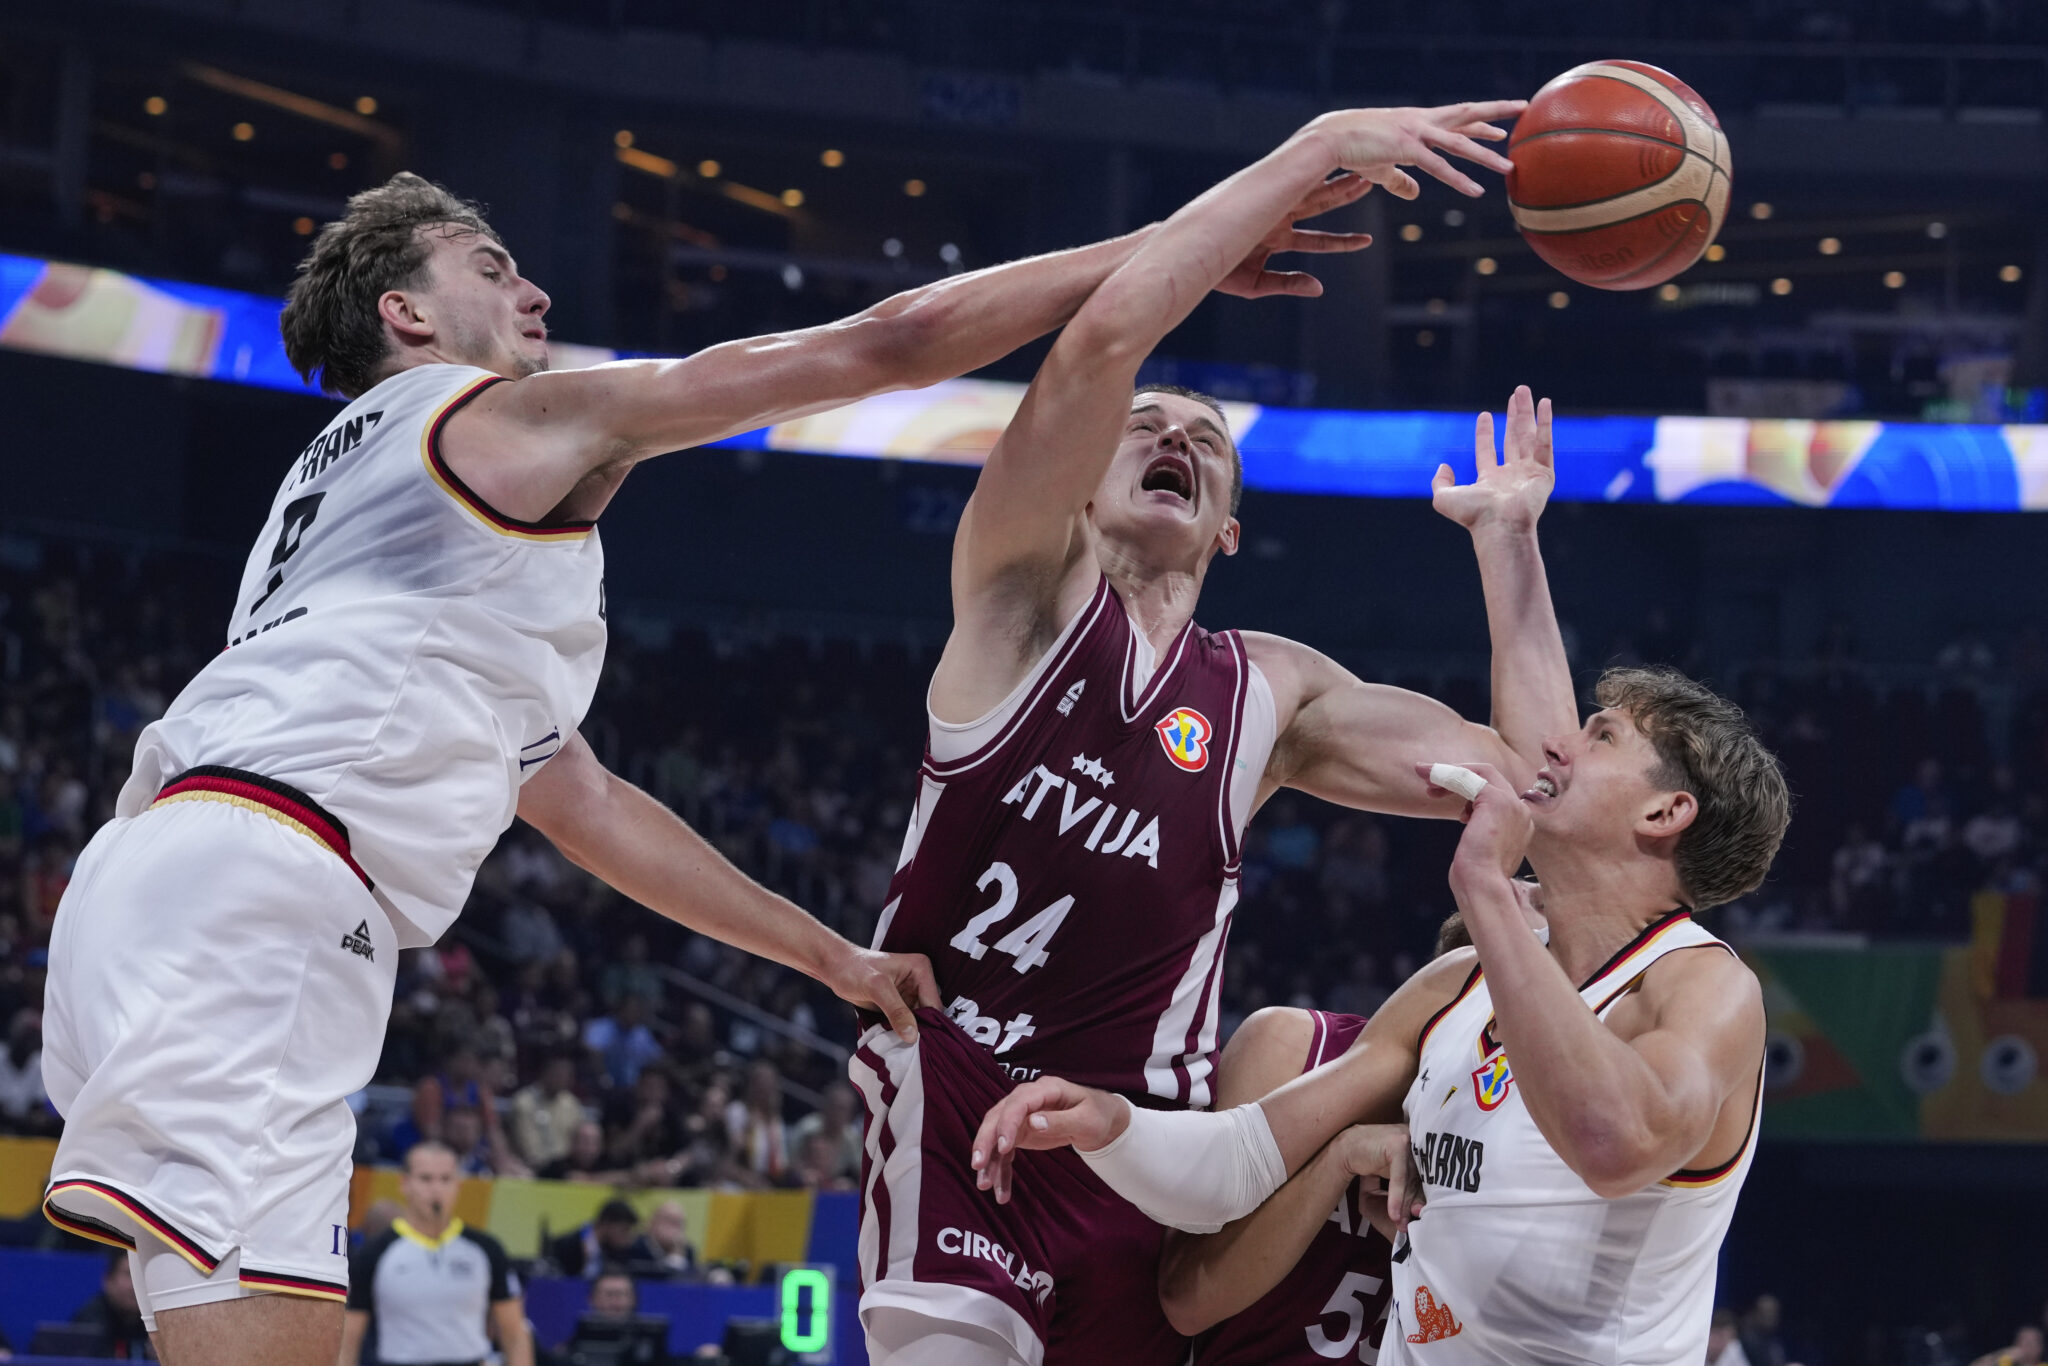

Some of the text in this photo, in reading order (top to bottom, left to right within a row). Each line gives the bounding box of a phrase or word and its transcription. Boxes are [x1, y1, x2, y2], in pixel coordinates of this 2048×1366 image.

[340, 933, 376, 964] PEAK
[949, 861, 1076, 975] 24
[780, 1268, 829, 1353] 0
